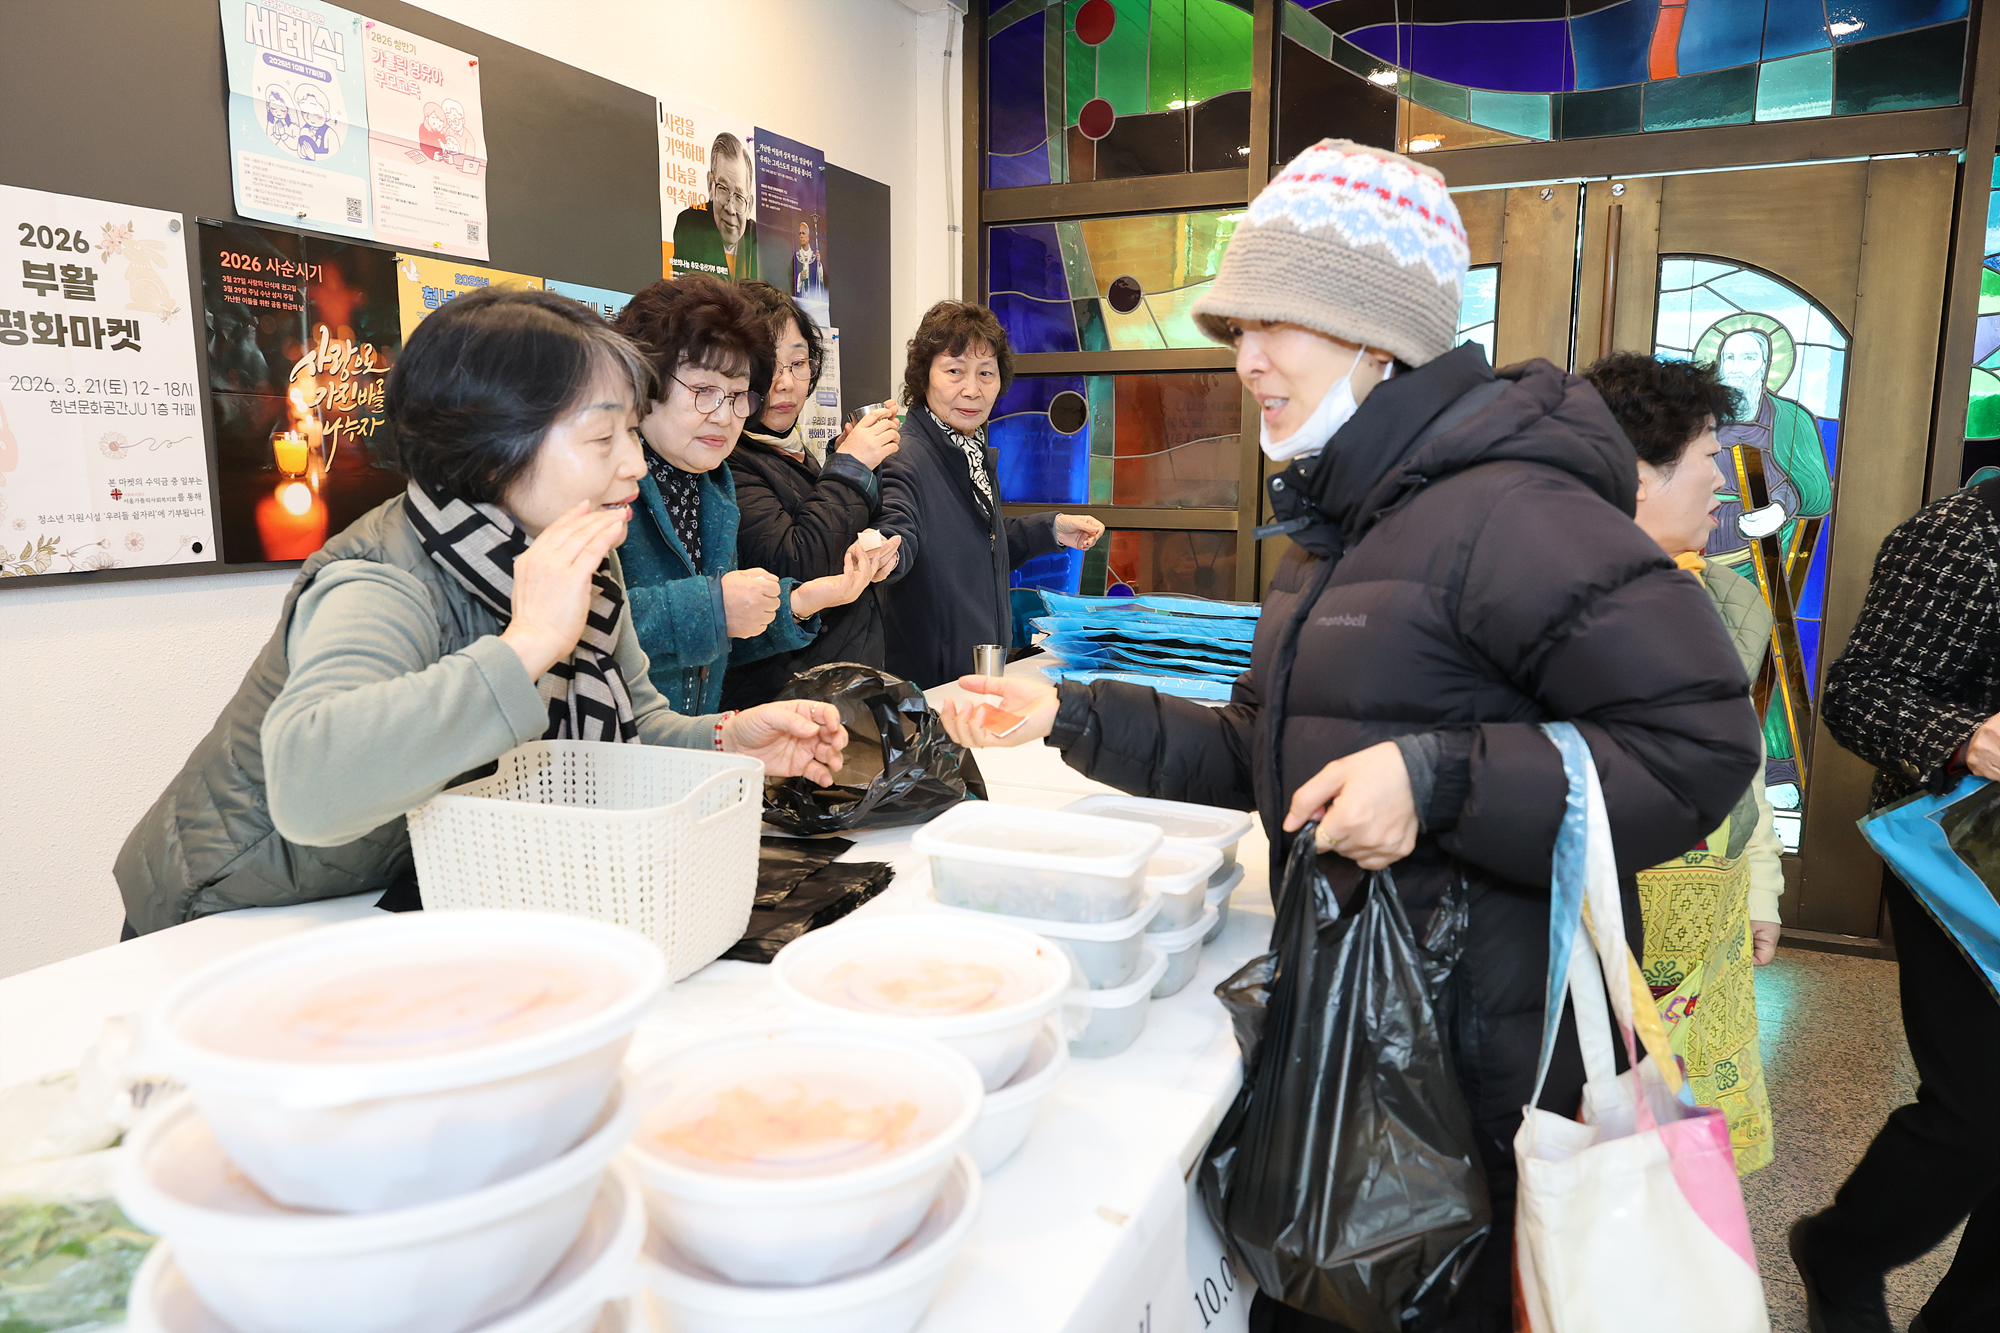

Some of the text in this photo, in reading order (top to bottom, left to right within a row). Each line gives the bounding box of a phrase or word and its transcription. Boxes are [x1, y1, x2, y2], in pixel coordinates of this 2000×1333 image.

[309, 12, 326, 25] 위한
[245, 2, 346, 72] 세례식
[371, 31, 417, 56] 2026 상반기
[372, 47, 444, 87] 가톨릭 영유아
[374, 68, 421, 100] 부모교육
[664, 112, 695, 139] 사랑을
[664, 136, 706, 165] 기억하며
[666, 162, 697, 187] 나눔을
[666, 185, 708, 212] 약속해요
[18, 222, 90, 254] 2026
[219, 250, 322, 283] 2026 사순시기
[22, 260, 98, 302] 부활
[222, 275, 297, 292] 3월 27일 사랑의 단식재 권고일
[222, 285, 294, 301] 3월 29일 주님 수난 성지 주일
[223, 294, 241, 303] 가난한
[241, 296, 258, 306] 이들을
[259, 299, 270, 308] 위한
[282, 302, 298, 311] 헌금의
[421, 285, 464, 310] 청년
[0, 308, 142, 353] 평화마켓
[290, 325, 391, 383] 사랑으로
[9, 375, 60, 394] 2026.
[64, 377, 81, 395] 3.
[84, 378, 128, 396] 21(토)
[133, 381, 150, 396] 12
[164, 382, 194, 397] 18시
[308, 378, 386, 413] 가진 바를
[50, 400, 196, 417] 청년문화공간JU 1층 카페
[811, 415, 826, 426] 우리의
[323, 415, 385, 473] 나누자
[808, 428, 826, 439] 평화의
[108, 476, 203, 488] 본 마켓의 수익금 중 일부는
[187, 492, 202, 502] 통해
[38, 514, 64, 525] 청소년
[67, 512, 101, 523] 지원시설
[103, 511, 129, 522] '우리들
[167, 508, 207, 518] 기부됩니다.
[1194, 1256, 1237, 1329] 10,0
